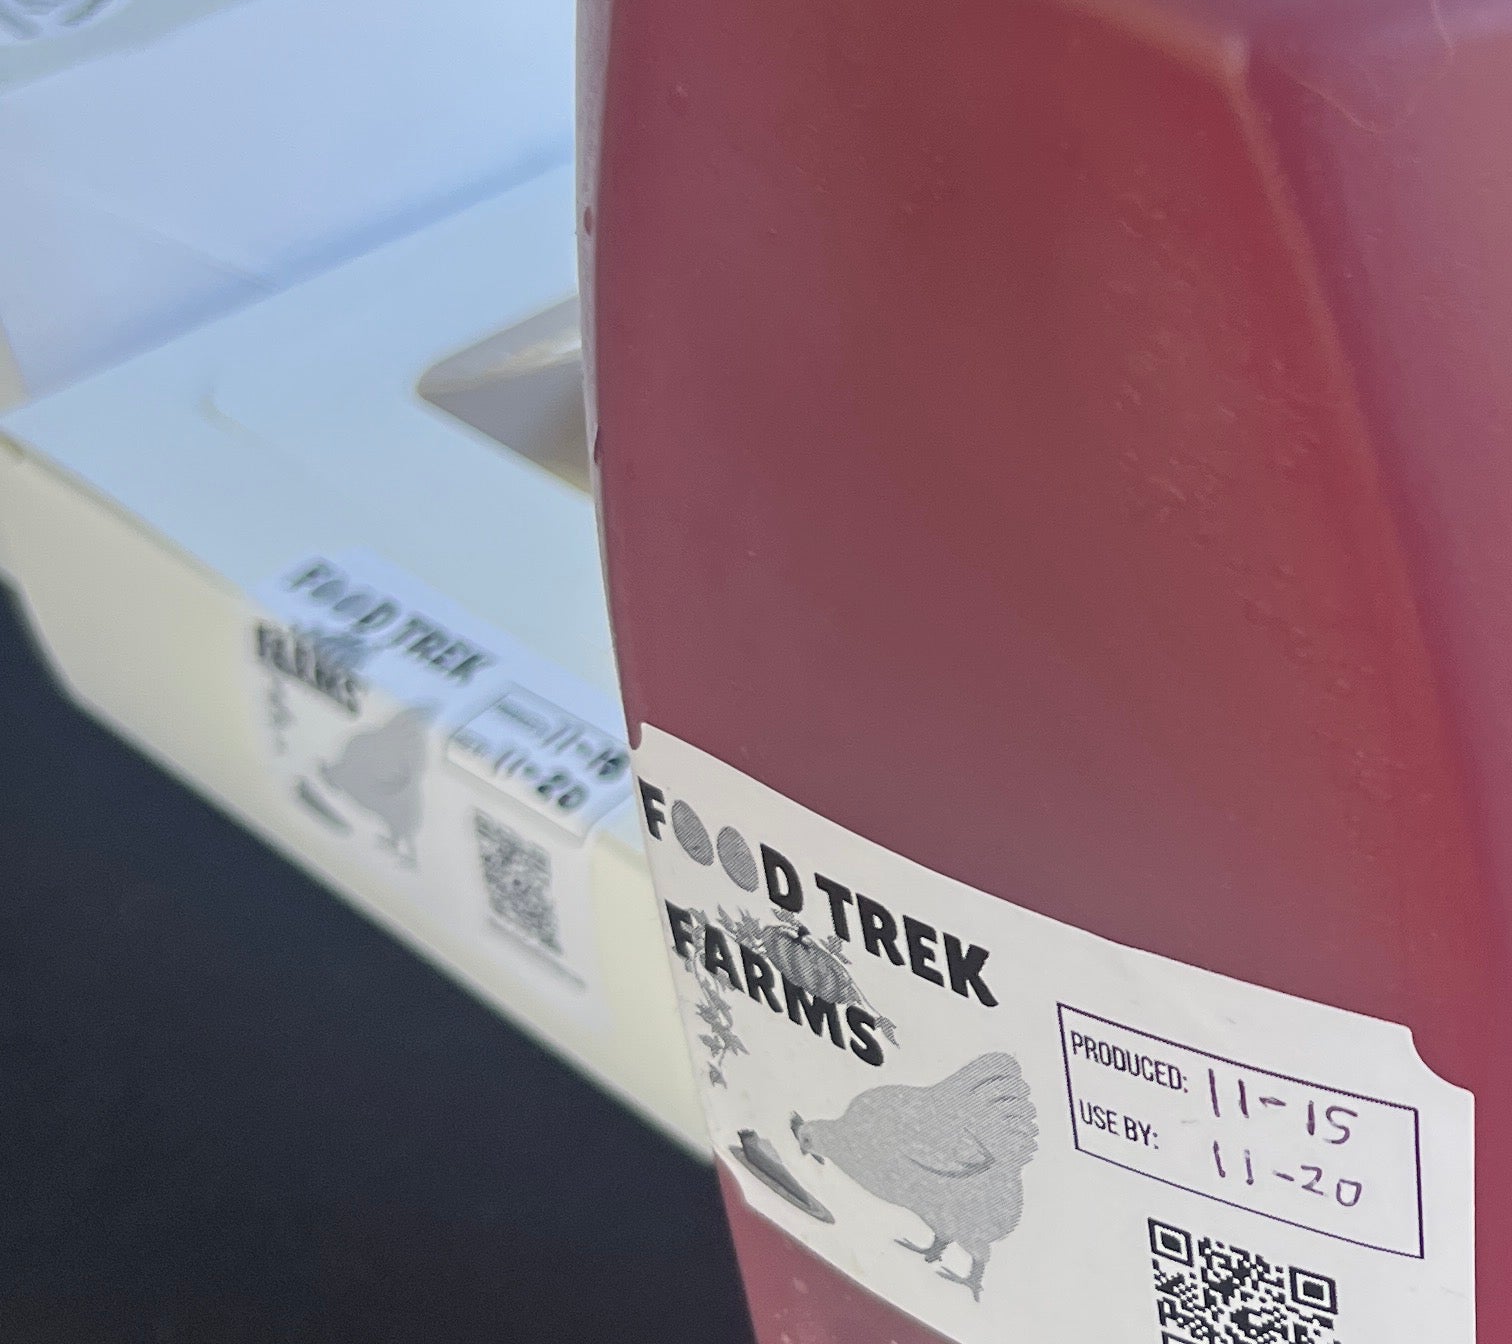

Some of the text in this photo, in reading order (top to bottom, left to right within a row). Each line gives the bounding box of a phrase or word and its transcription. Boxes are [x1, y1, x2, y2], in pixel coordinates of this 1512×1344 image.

[394, 613, 494, 683] TREK
[637, 775, 1000, 1008] FOOD TREK
[664, 899, 885, 1068] FARMS
[1070, 1029, 1360, 1146] PRODUCED: 11-15
[1078, 1098, 1363, 1208] USE BY: 11-20
